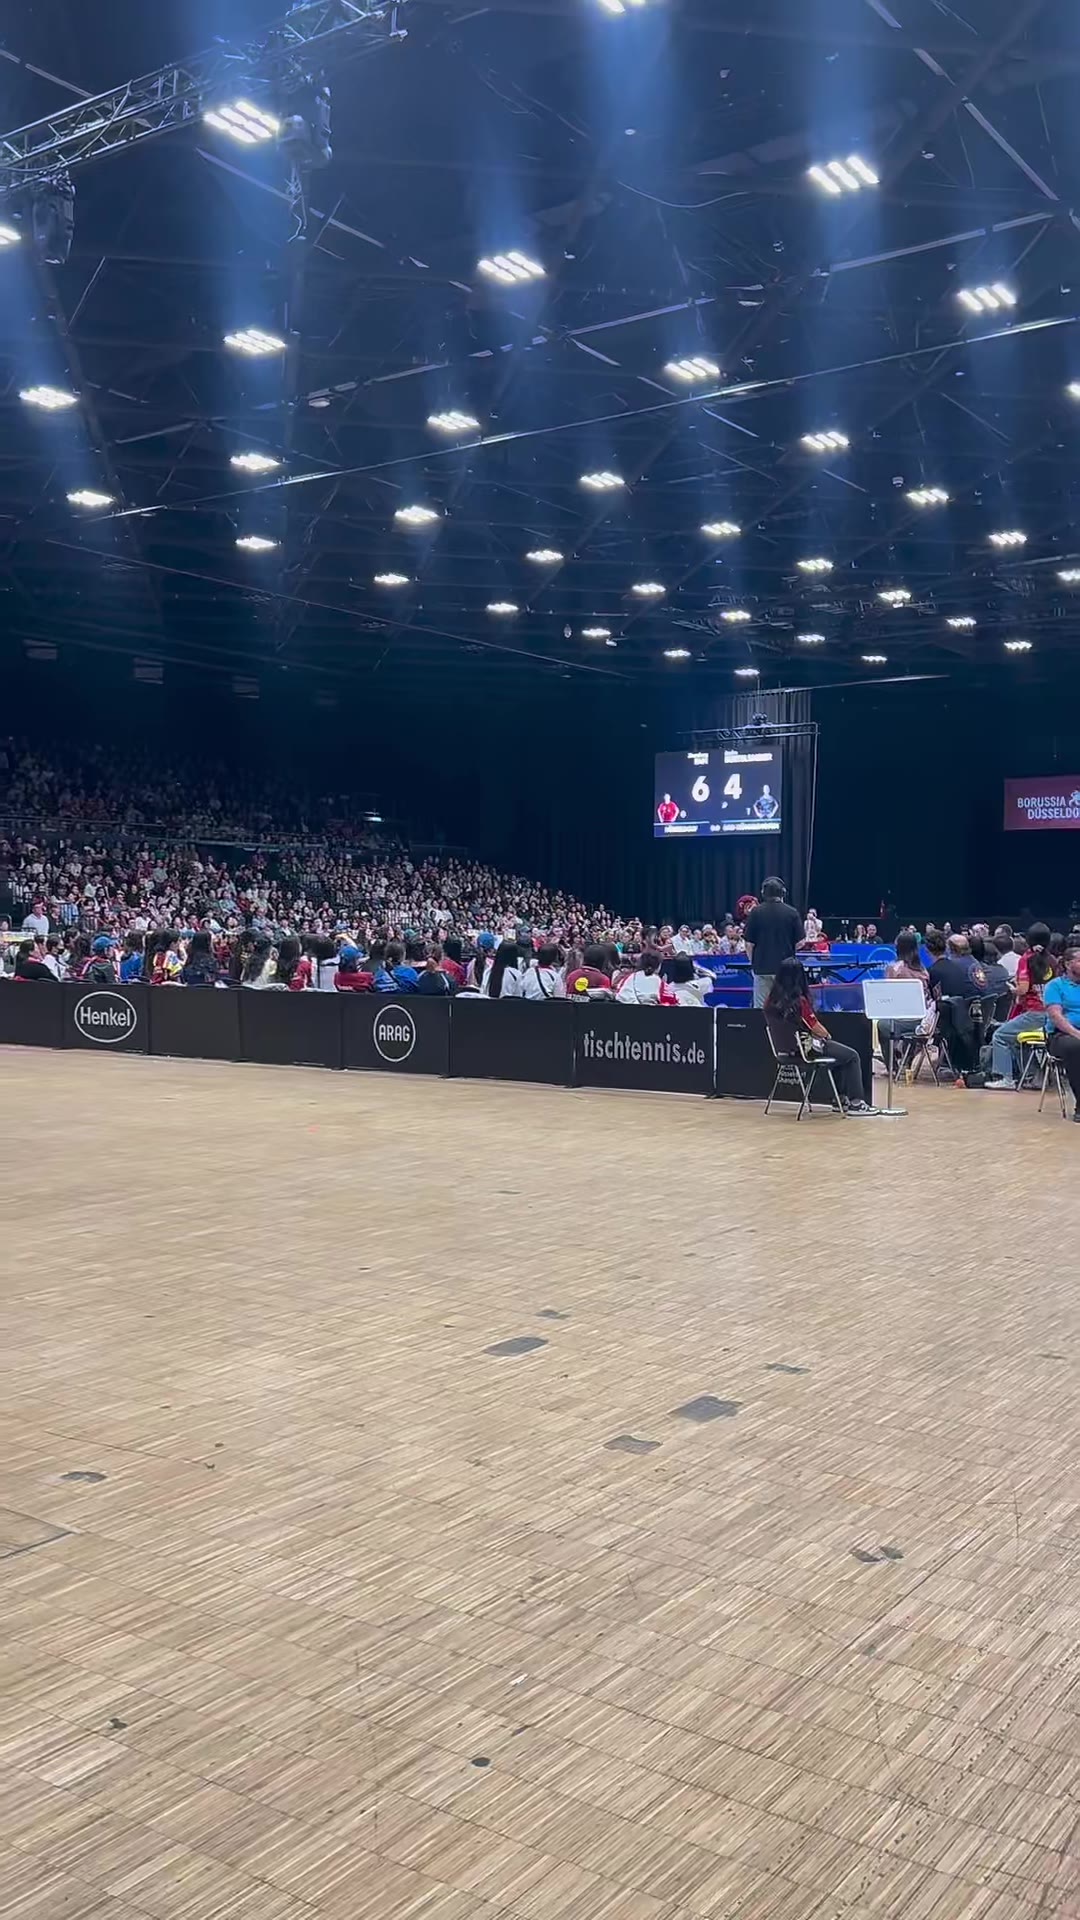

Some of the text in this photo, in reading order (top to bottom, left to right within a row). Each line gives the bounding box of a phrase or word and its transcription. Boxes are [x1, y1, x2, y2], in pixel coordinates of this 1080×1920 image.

[691, 774, 742, 802] 6 4
[1017, 796, 1066, 808] BORUSSIA
[80, 1006, 130, 1027] Henkel
[379, 1024, 410, 1042] ARAG
[584, 1030, 705, 1064] tischtennis.de
